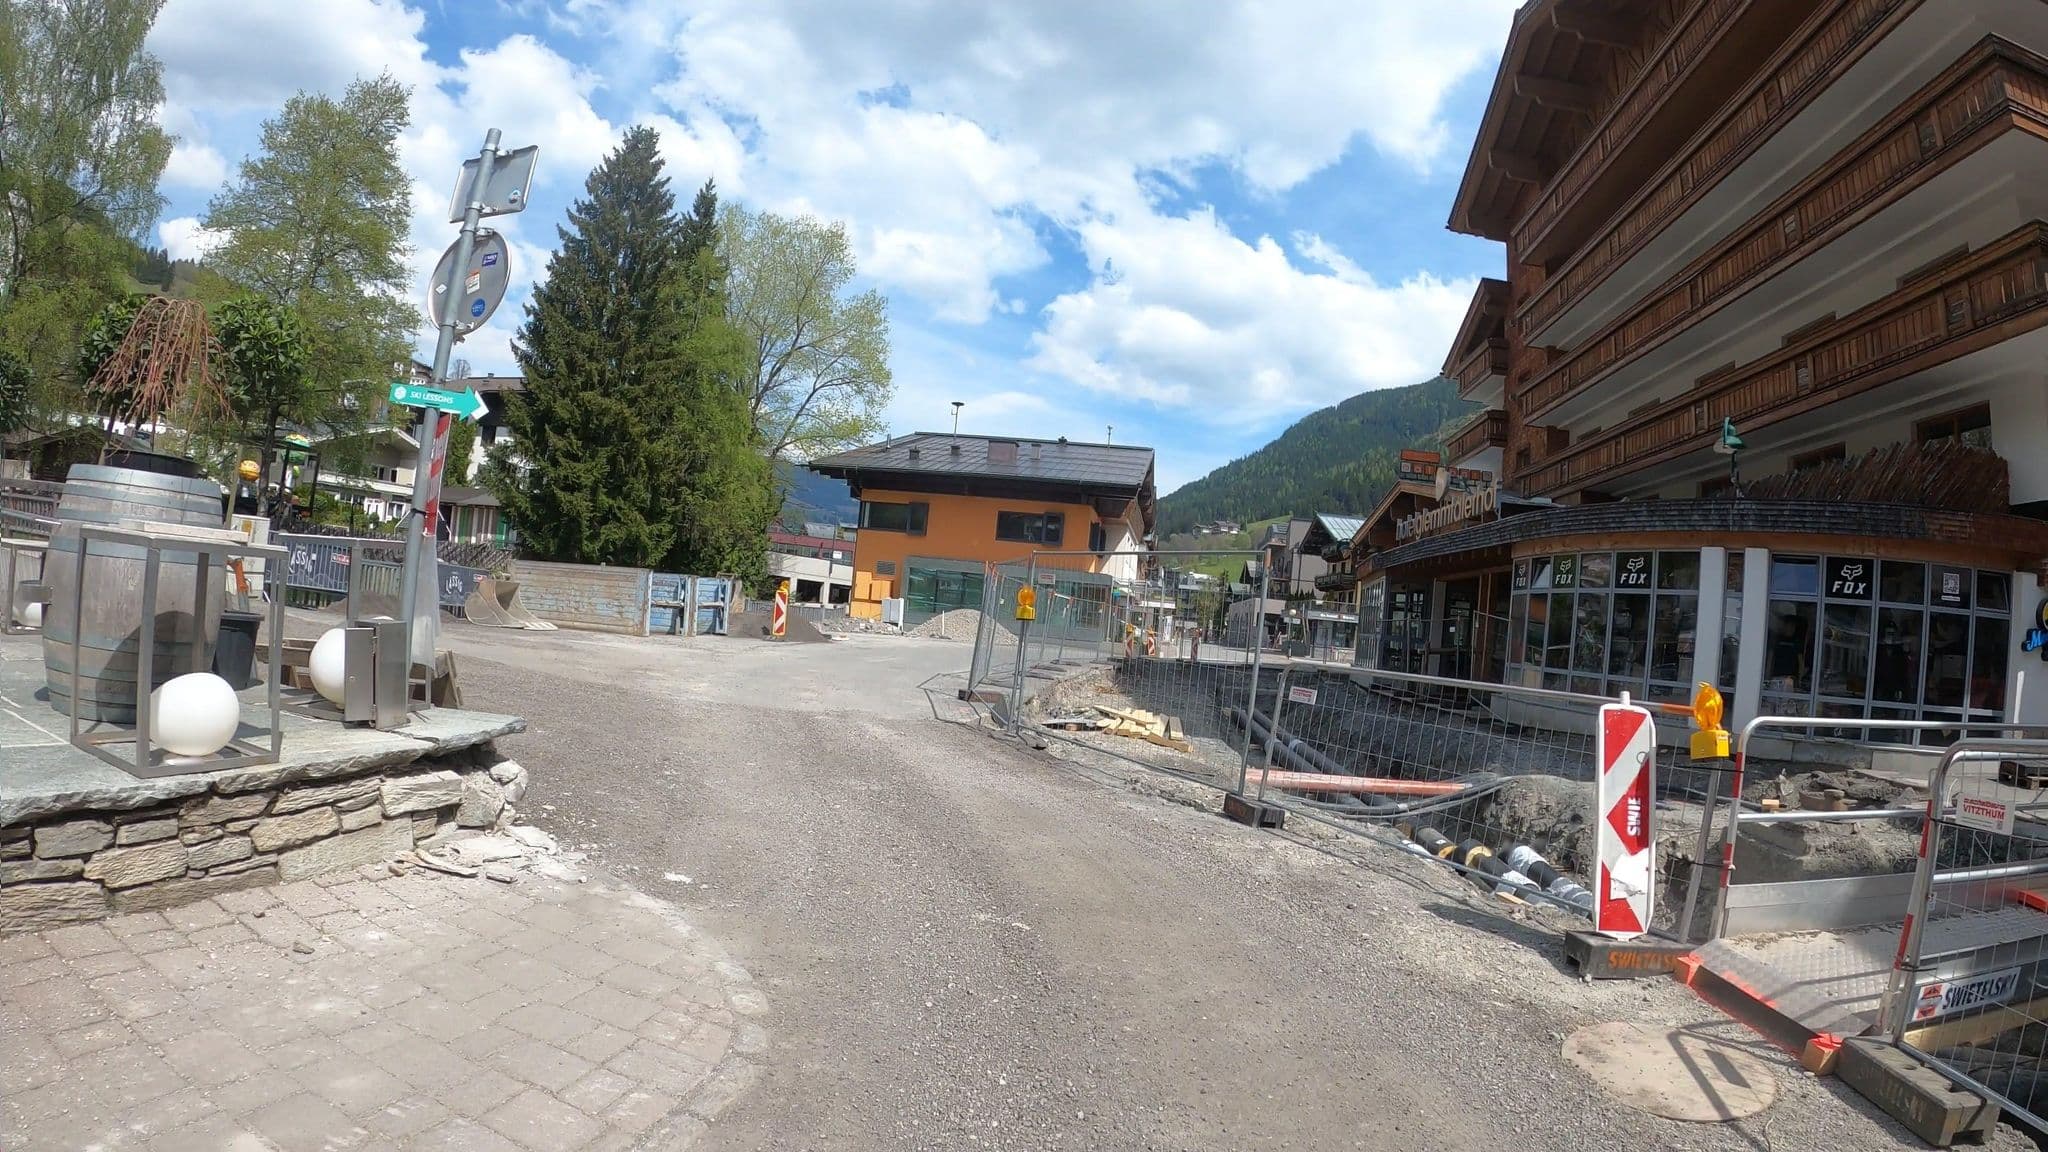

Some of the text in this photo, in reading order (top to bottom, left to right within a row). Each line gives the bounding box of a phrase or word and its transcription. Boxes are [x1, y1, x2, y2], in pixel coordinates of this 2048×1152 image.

[410, 391, 454, 404] SKI LESSONS
[1515, 577, 1526, 587] FOX
[1555, 574, 1573, 585] FOX
[1620, 573, 1647, 585] FOX
[1832, 581, 1867, 594] FOX
[1963, 804, 2005, 820] VITZTHUM
[1942, 973, 2017, 1010] SWIETELSKI
